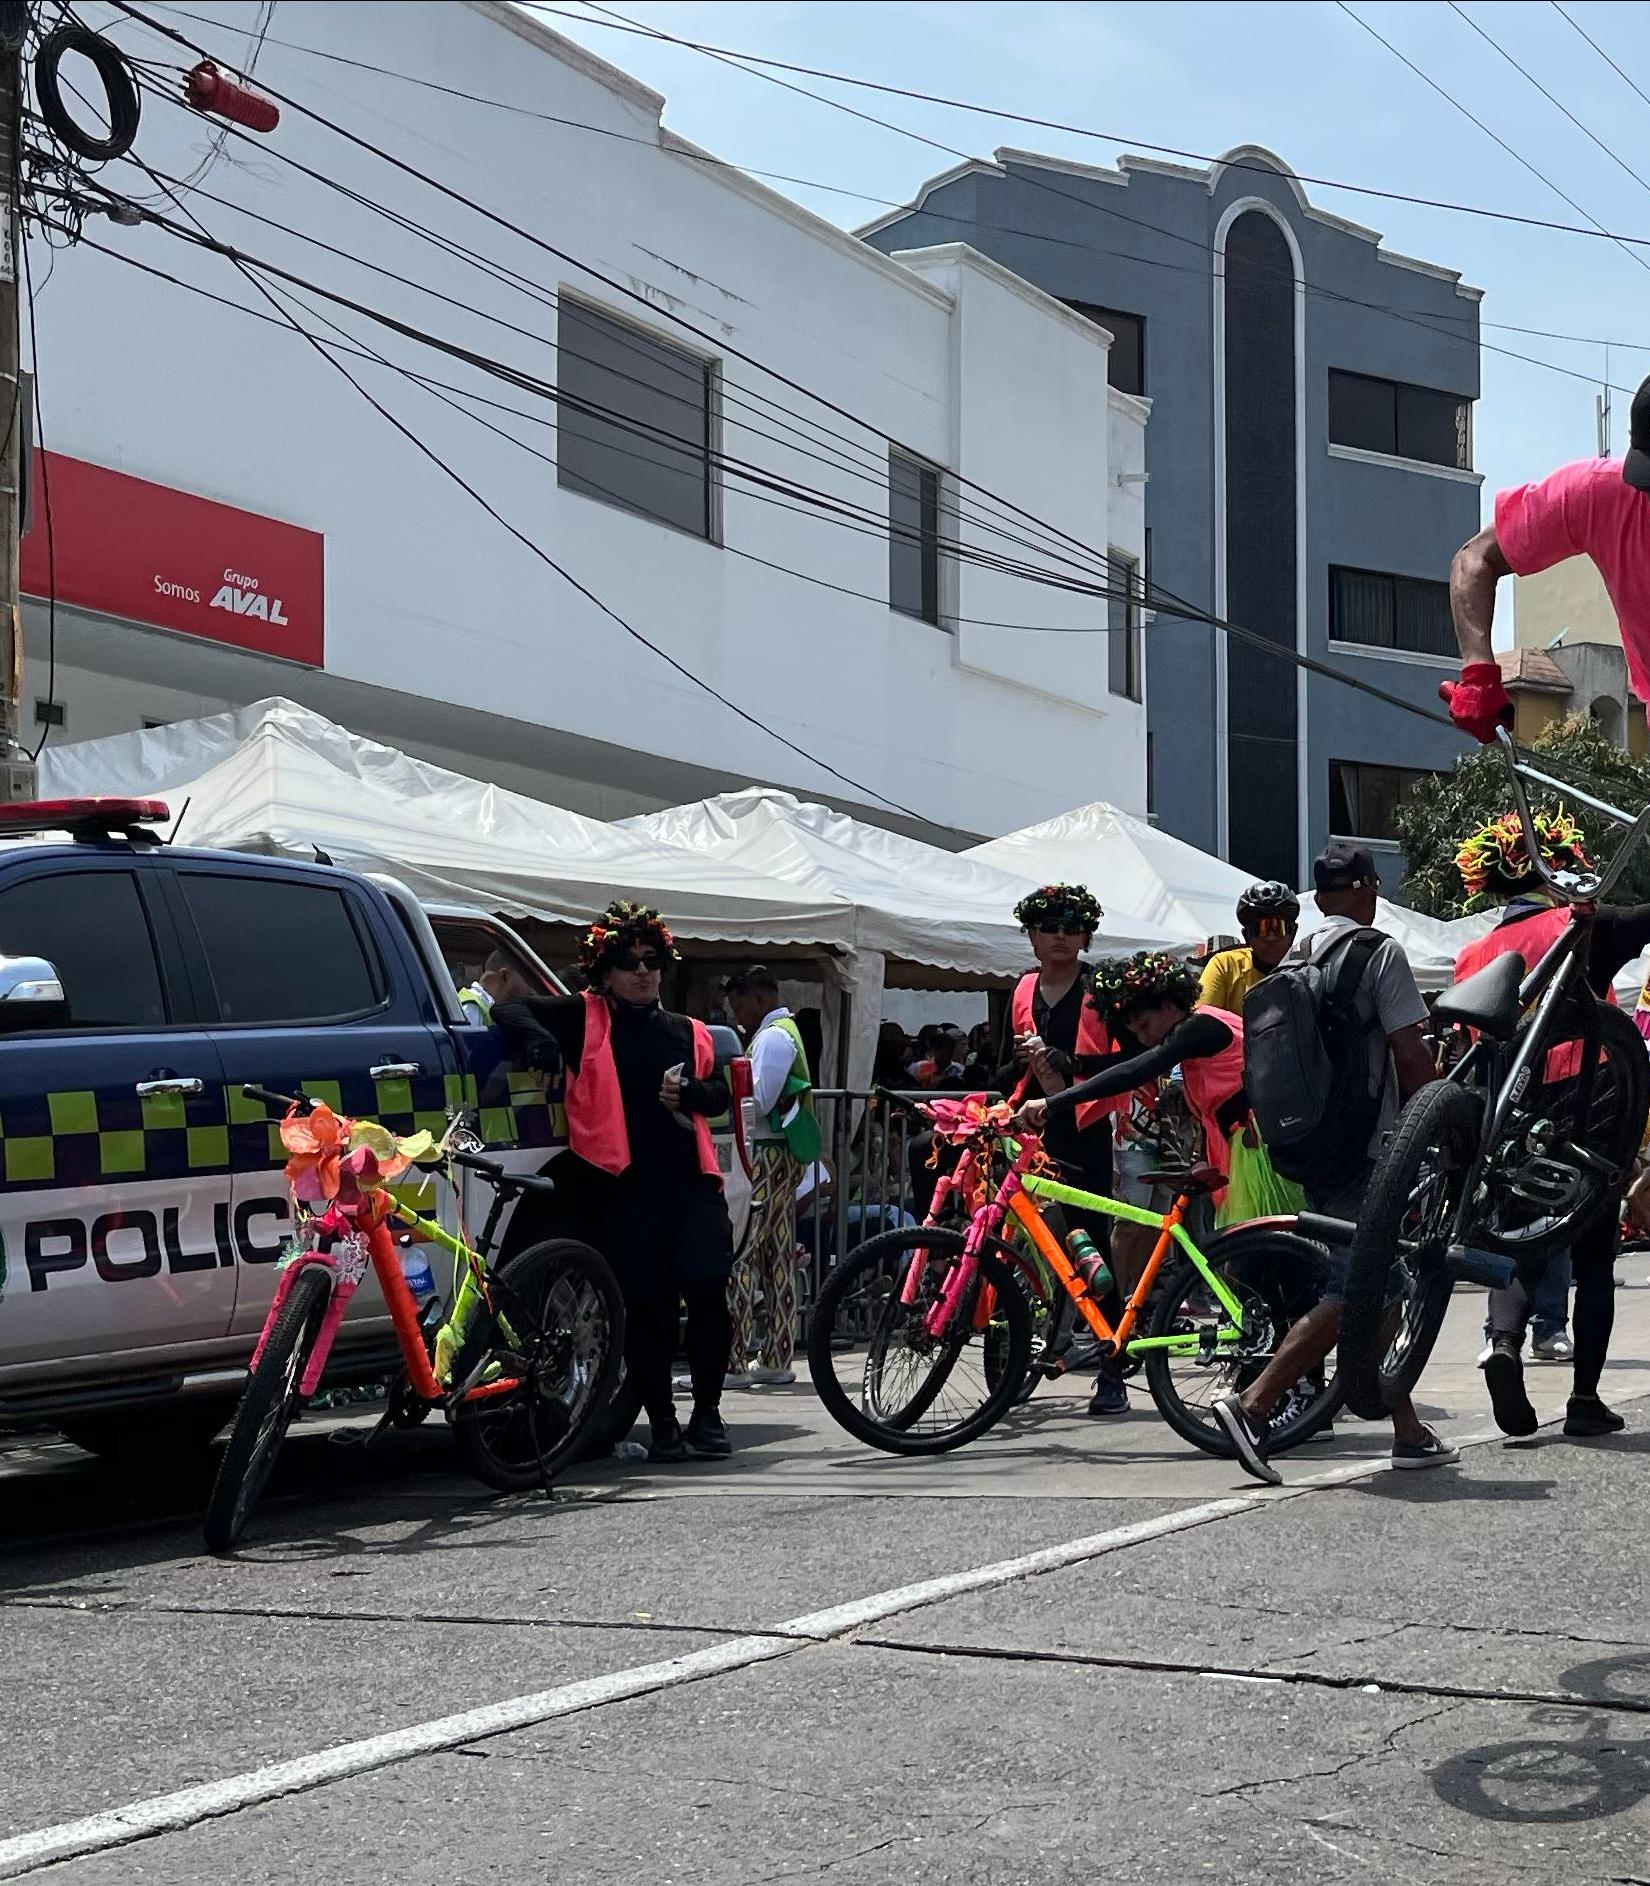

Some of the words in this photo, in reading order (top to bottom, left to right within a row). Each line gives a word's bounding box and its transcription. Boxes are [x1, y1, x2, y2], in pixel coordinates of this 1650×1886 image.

[154, 574, 200, 603] Somos
[223, 568, 259, 590] Grupo
[209, 585, 289, 626] AVAL
[25, 1196, 341, 1292] POLIC
